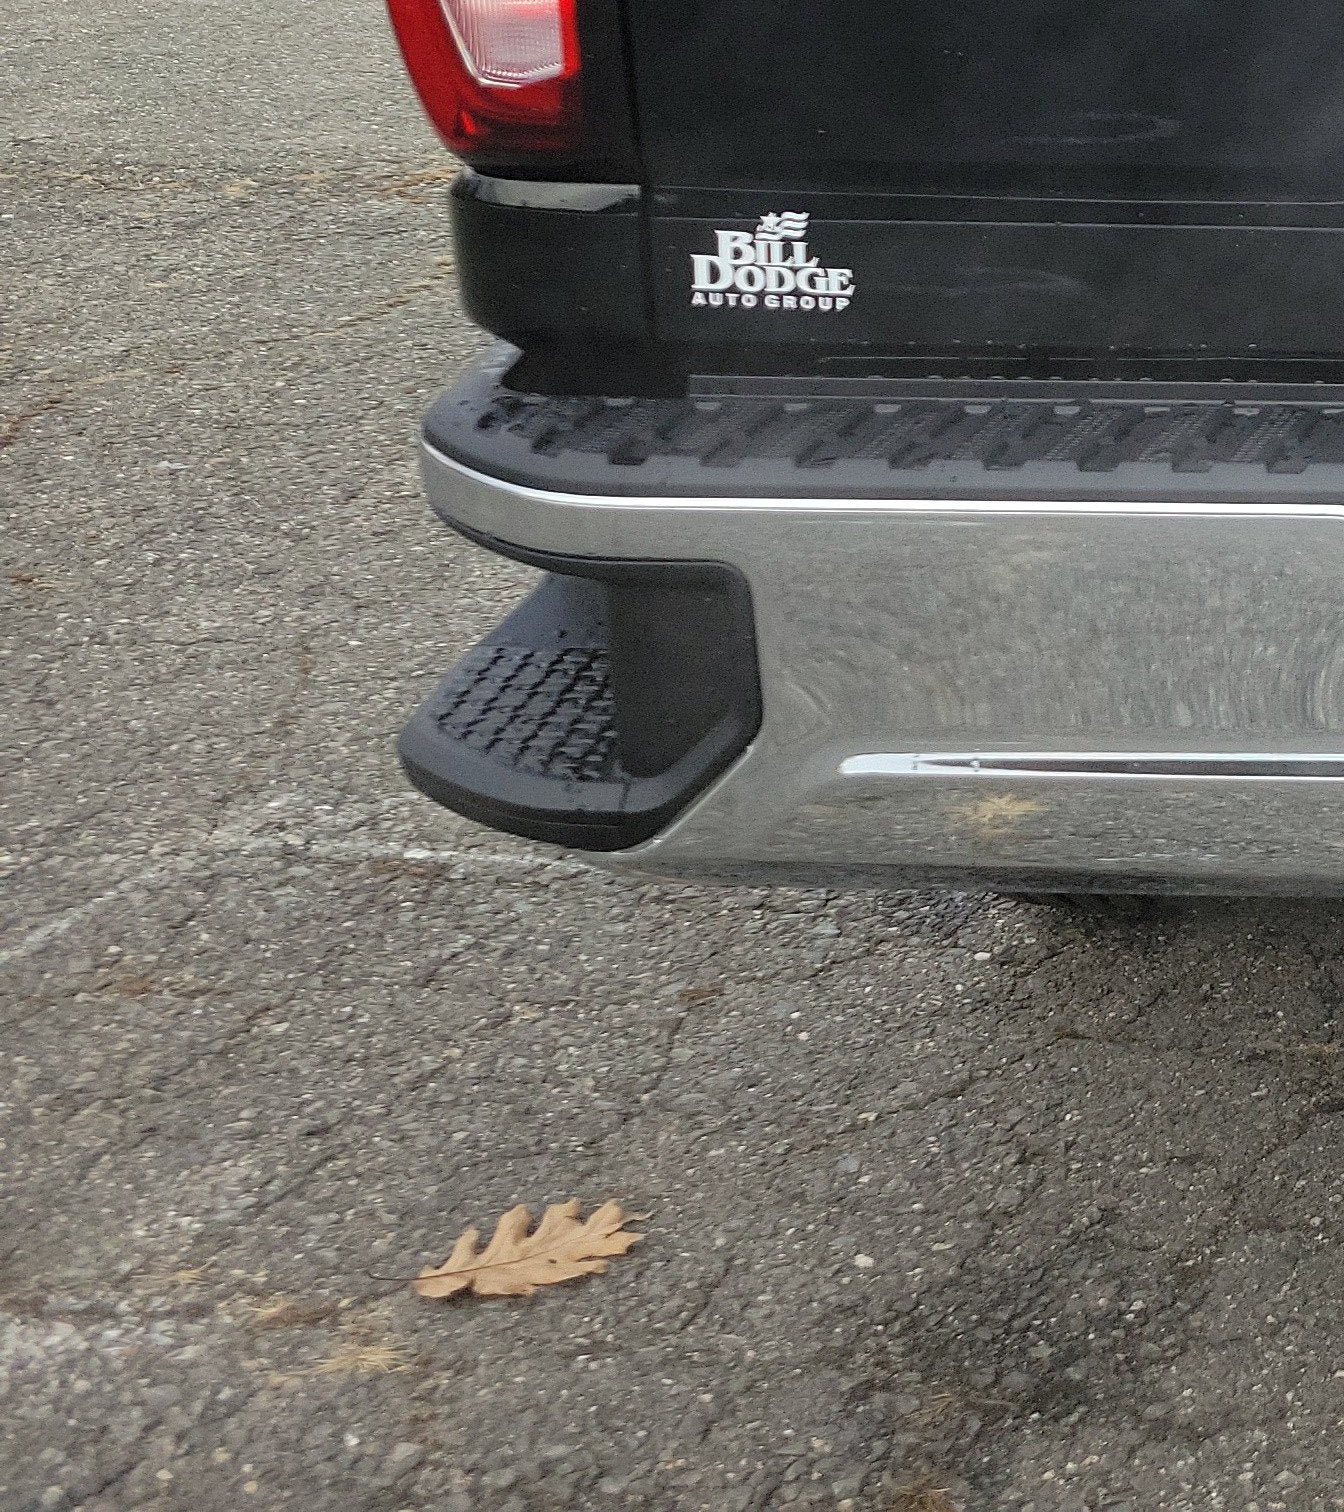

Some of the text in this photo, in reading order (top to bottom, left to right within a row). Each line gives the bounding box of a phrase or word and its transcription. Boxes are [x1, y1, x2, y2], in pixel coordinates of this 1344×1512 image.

[714, 229, 820, 268] BILL
[689, 253, 856, 297] DODGE
[690, 291, 851, 313] AUTO GROUP
